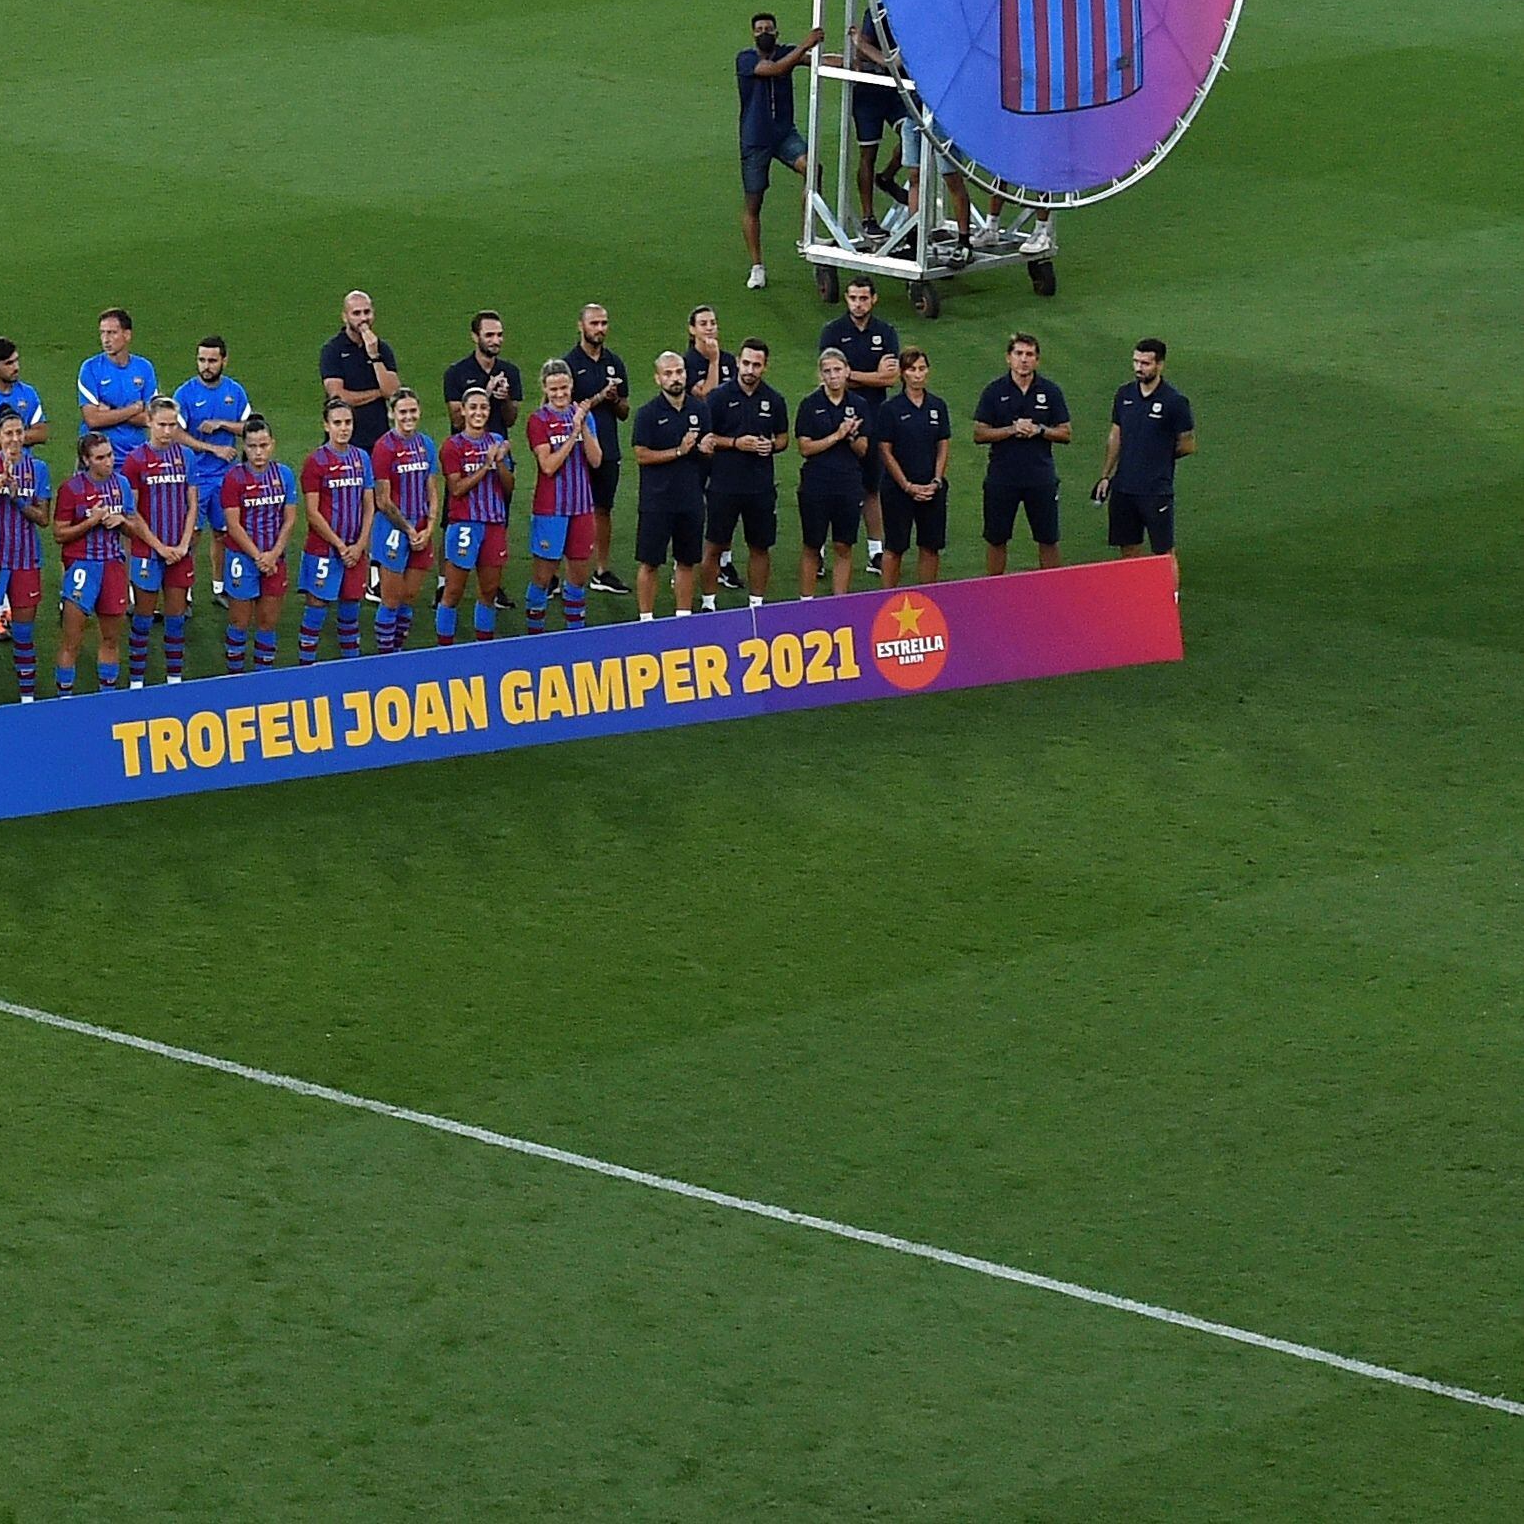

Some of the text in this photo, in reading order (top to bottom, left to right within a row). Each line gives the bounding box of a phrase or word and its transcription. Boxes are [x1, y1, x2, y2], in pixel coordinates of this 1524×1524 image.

[386, 529, 400, 550] 4
[458, 527, 471, 548] 3
[230, 557, 242, 578] 6
[316, 558, 329, 579] 5
[73, 568, 86, 589] 9
[876, 635, 945, 659] ESTRELLA
[112, 626, 860, 777] TROFEU JOAN GAMPER 2021
